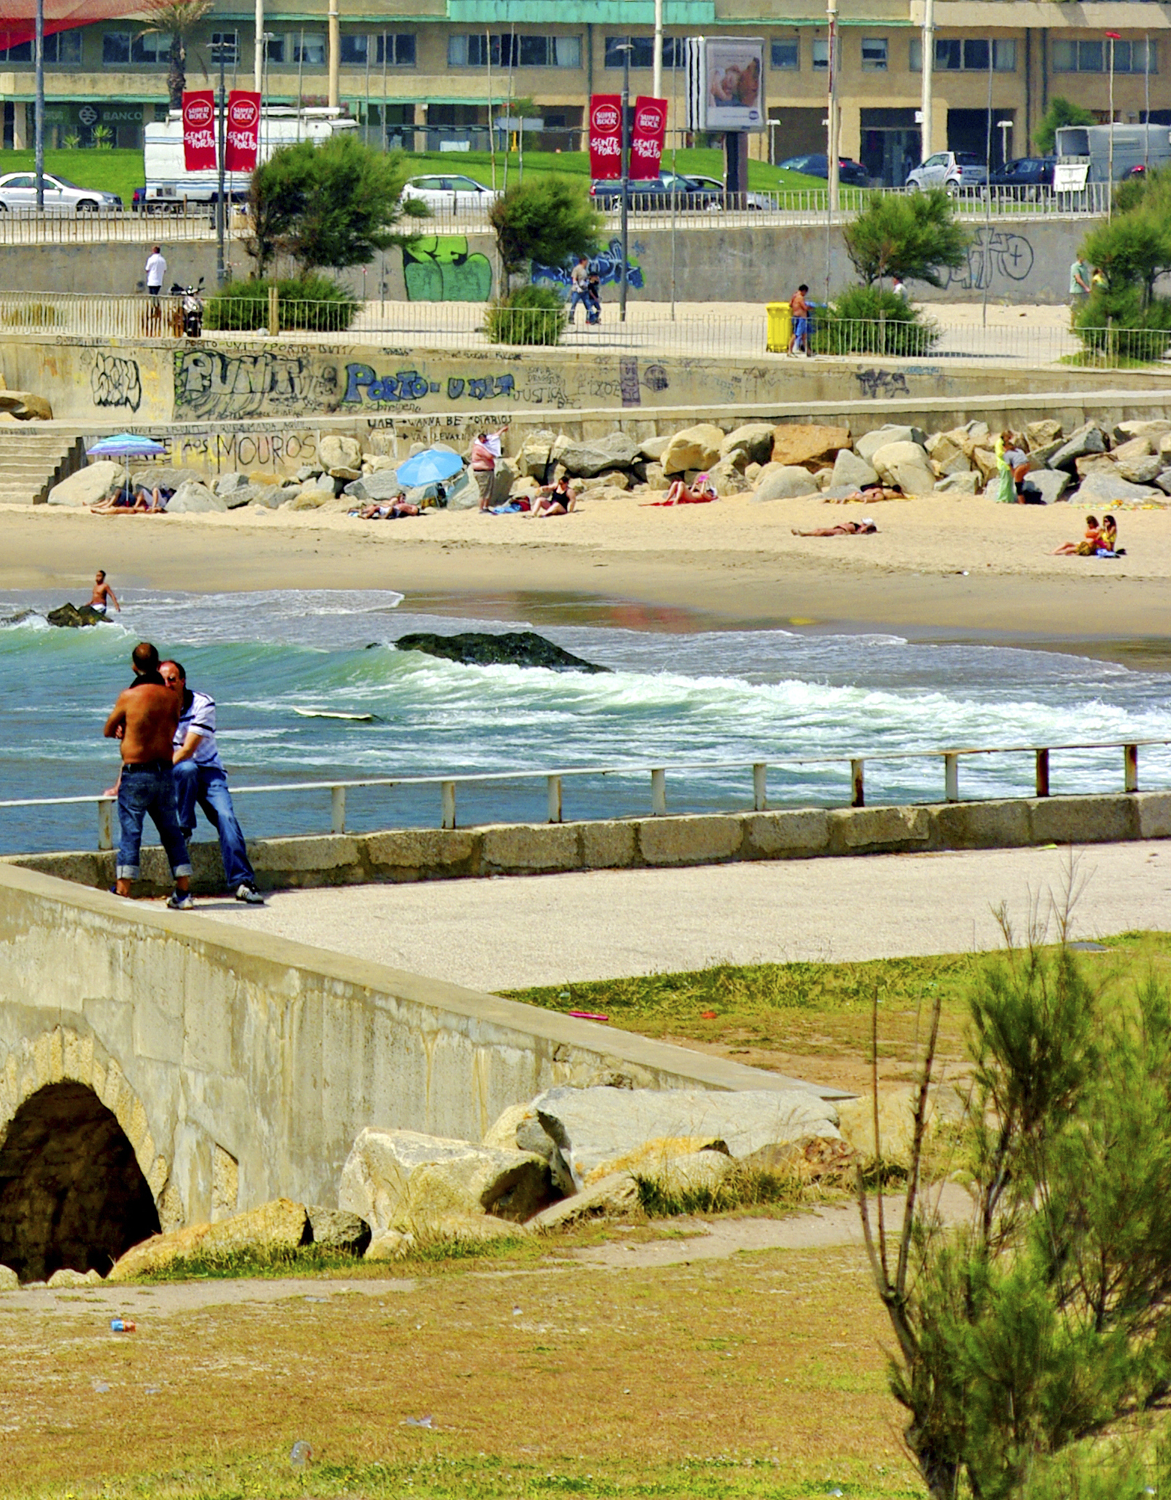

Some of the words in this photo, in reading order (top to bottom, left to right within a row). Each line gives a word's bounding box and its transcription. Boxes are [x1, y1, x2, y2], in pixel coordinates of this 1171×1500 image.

[103, 111, 142, 120] BANCO
[233, 113, 252, 121] BOCK
[596, 111, 617, 119] SUPER
[640, 114, 660, 123] SUPER
[639, 120, 659, 128] BOCK
[184, 130, 213, 141] SENTE
[227, 131, 255, 141] SENTE
[192, 139, 215, 149] PORTO
[233, 139, 257, 150] PORTO
[591, 137, 619, 148] SENTE
[632, 139, 659, 149] SENTE
[597, 145, 621, 156] PORTO
[638, 147, 661, 159] PORTO
[217, 433, 317, 475] MOUROS
